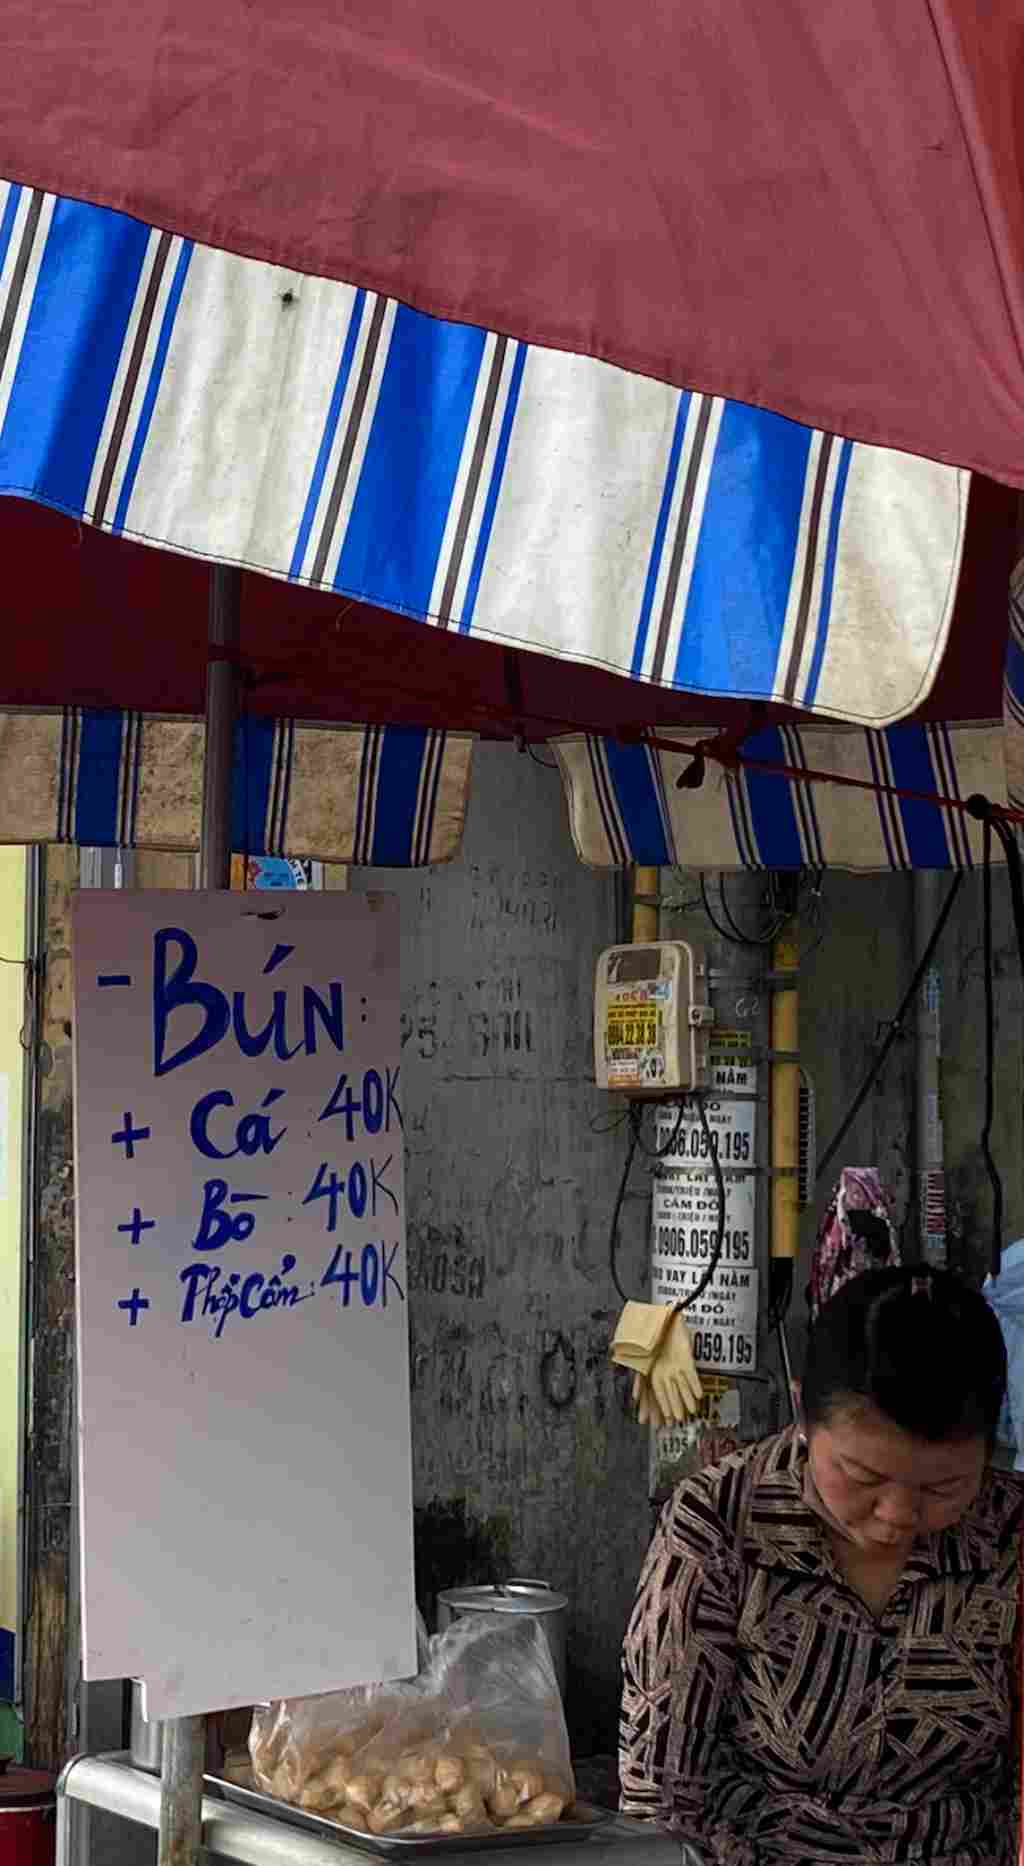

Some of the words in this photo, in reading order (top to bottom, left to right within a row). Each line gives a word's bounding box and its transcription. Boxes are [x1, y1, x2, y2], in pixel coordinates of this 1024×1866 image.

[318, 1065, 406, 1142] 40K
[302, 1154, 399, 1232] 40K
[319, 1241, 405, 1307] 40K
